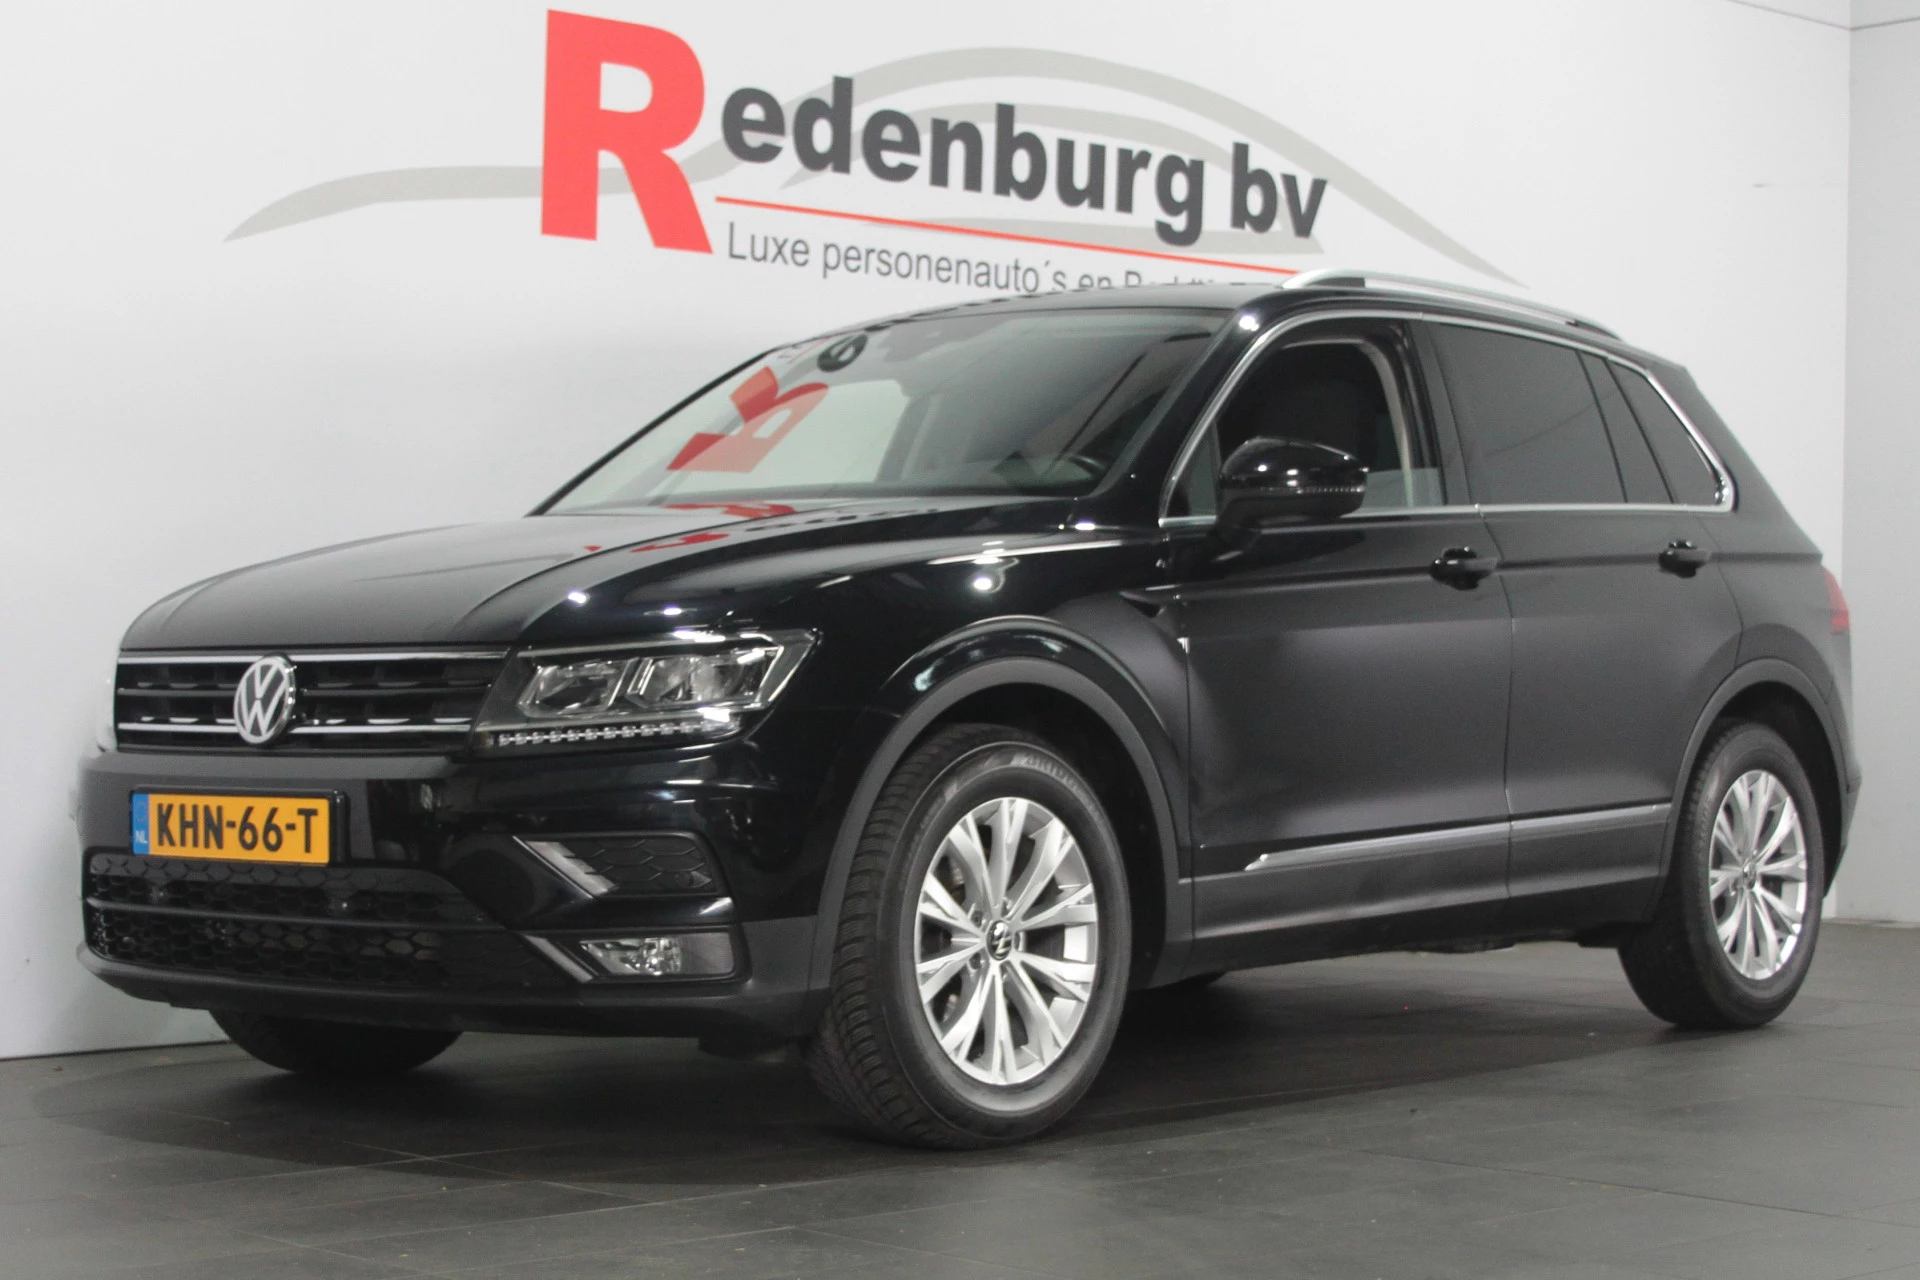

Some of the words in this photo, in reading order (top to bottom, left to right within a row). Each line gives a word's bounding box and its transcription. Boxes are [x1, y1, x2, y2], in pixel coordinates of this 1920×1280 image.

[541, 9, 1204, 255] Redenburg
[1231, 143, 1327, 238] bv
[728, 221, 809, 266] Luxe
[157, 803, 318, 853] KHN-66-T
